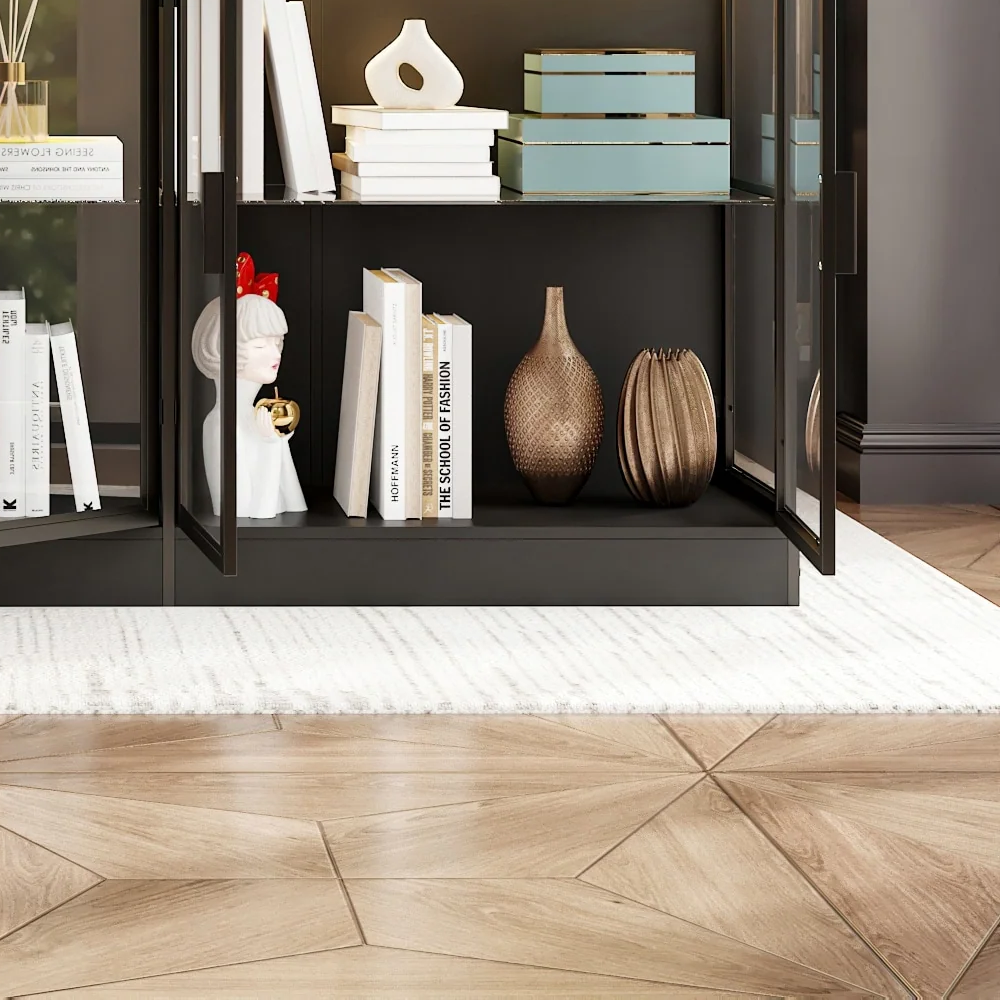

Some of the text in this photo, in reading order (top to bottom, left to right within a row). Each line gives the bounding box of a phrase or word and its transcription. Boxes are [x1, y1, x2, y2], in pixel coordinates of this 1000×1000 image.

[422, 374, 434, 420] HARRY POTTER
[422, 433, 434, 496] CHAMBER SECRETS
[439, 361, 451, 511] THE SCHOOL OF FASHION
[391, 444, 399, 502] HOFFMANN
